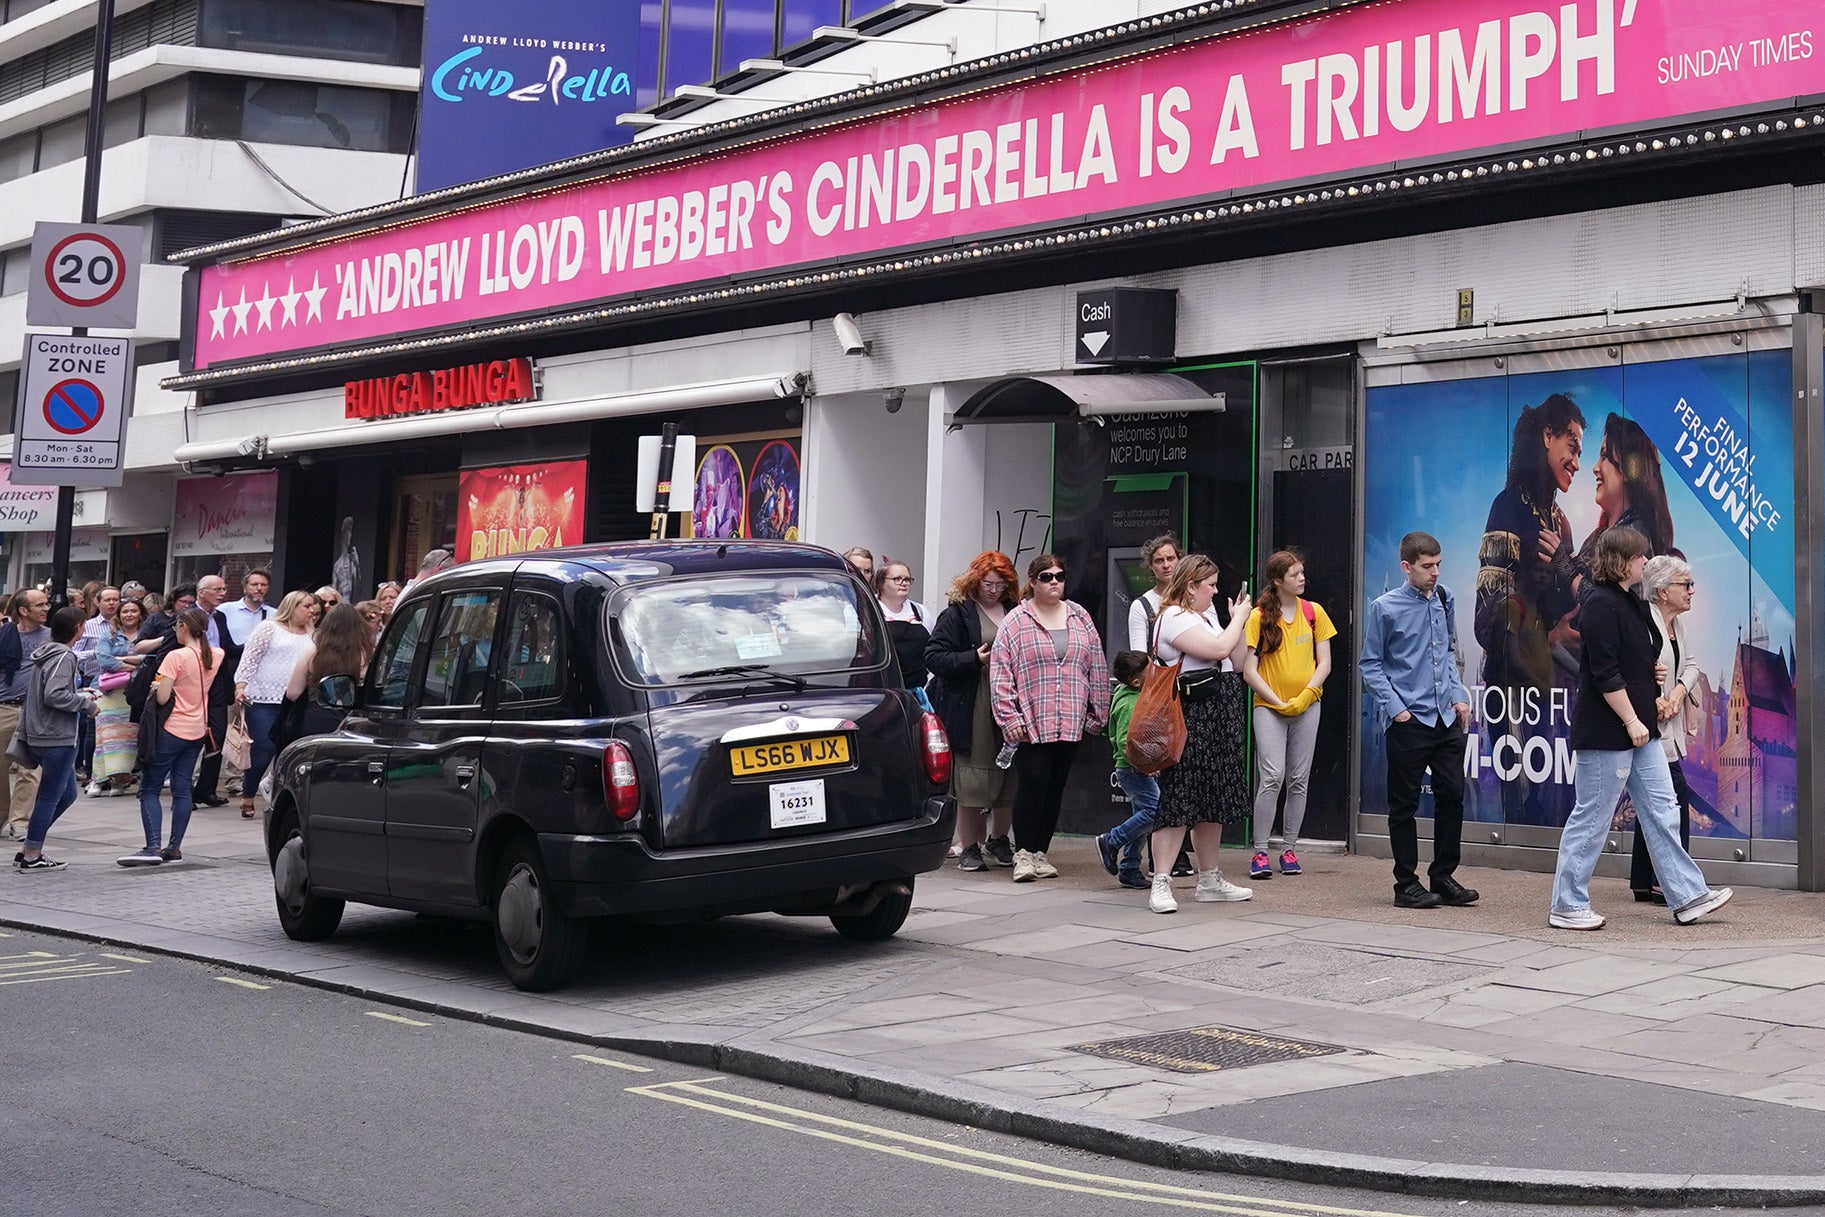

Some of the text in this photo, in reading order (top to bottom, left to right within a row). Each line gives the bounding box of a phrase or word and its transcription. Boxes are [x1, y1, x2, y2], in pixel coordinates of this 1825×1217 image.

[462, 34, 606, 53] ANDREW LLOYD WEBBER'S
[1656, 29, 1814, 86] SUNDAY TIMES
[478, 215, 585, 296] LLOYD
[598, 170, 793, 275] WEBBER'S
[806, 103, 1118, 238] CINDERELLA
[1138, 85, 1191, 178] IS
[1209, 73, 1260, 166] A
[58, 254, 114, 285] 20
[1081, 301, 1111, 322] Cash
[38, 341, 120, 356] Controlled
[48, 358, 106, 374] ZONE
[345, 358, 529, 419] BUNGA BUNGA
[1110, 422, 1188, 444] welcomes you to
[47, 444, 68, 452] Mon
[76, 444, 93, 453] Sat
[1110, 444, 1187, 466] NCP Drury Lane
[1713, 416, 1756, 476] FINAL
[24, 454, 48, 463] 8.30
[72, 455, 96, 464] 6.30
[98, 457, 113, 465] pm
[1289, 452, 1352, 471] CAR PAR
[1674, 397, 1781, 532] PERFORMANCE
[0, 490, 54, 501] ancers
[1674, 431, 1760, 540] 12 JUNE
[0, 506, 38, 524] Shop
[1464, 685, 1541, 726] TOUS
[741, 739, 840, 770] LS66 WJX
[1463, 733, 1577, 785] M-COM
[781, 796, 813, 810] 16231
